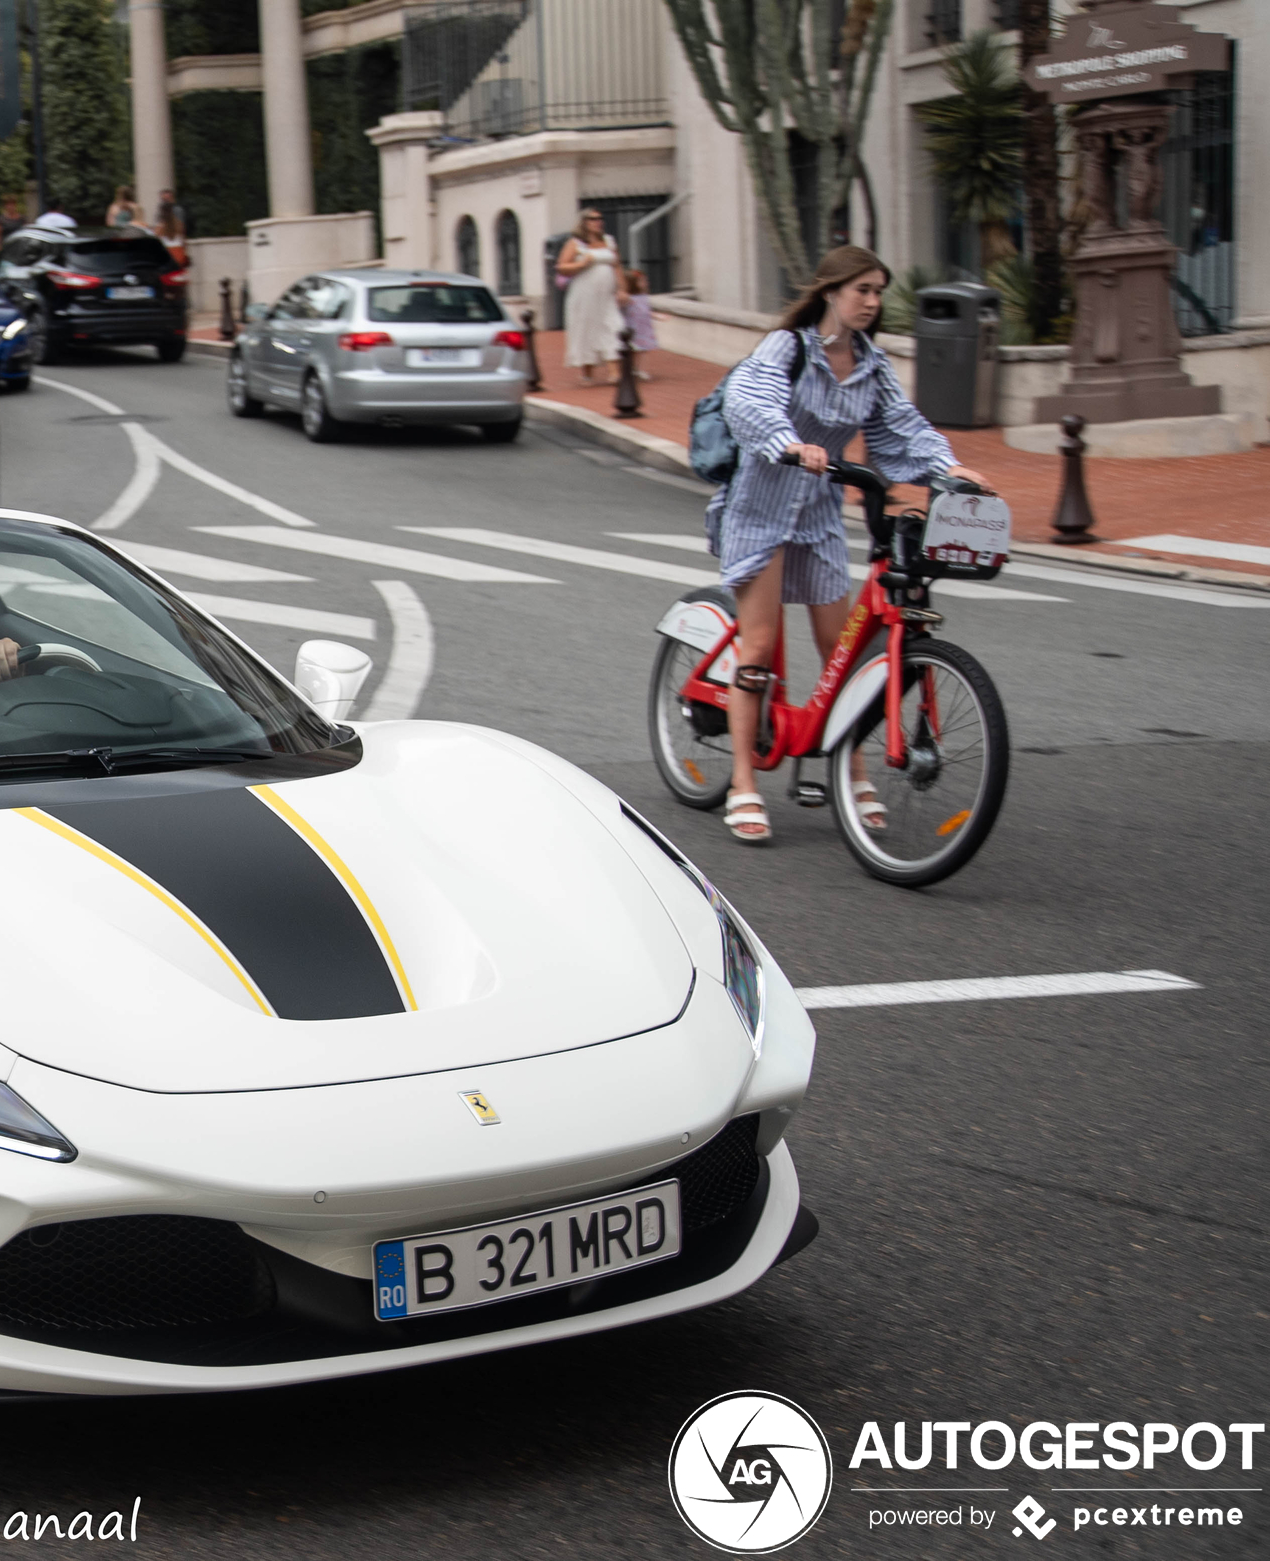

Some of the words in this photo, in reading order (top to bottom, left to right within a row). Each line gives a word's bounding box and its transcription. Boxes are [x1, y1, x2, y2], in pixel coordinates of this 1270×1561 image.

[415, 1243, 455, 1304] B
[476, 1220, 555, 1292] 321
[568, 1196, 666, 1273] MRD
[380, 1285, 404, 1309] RO
